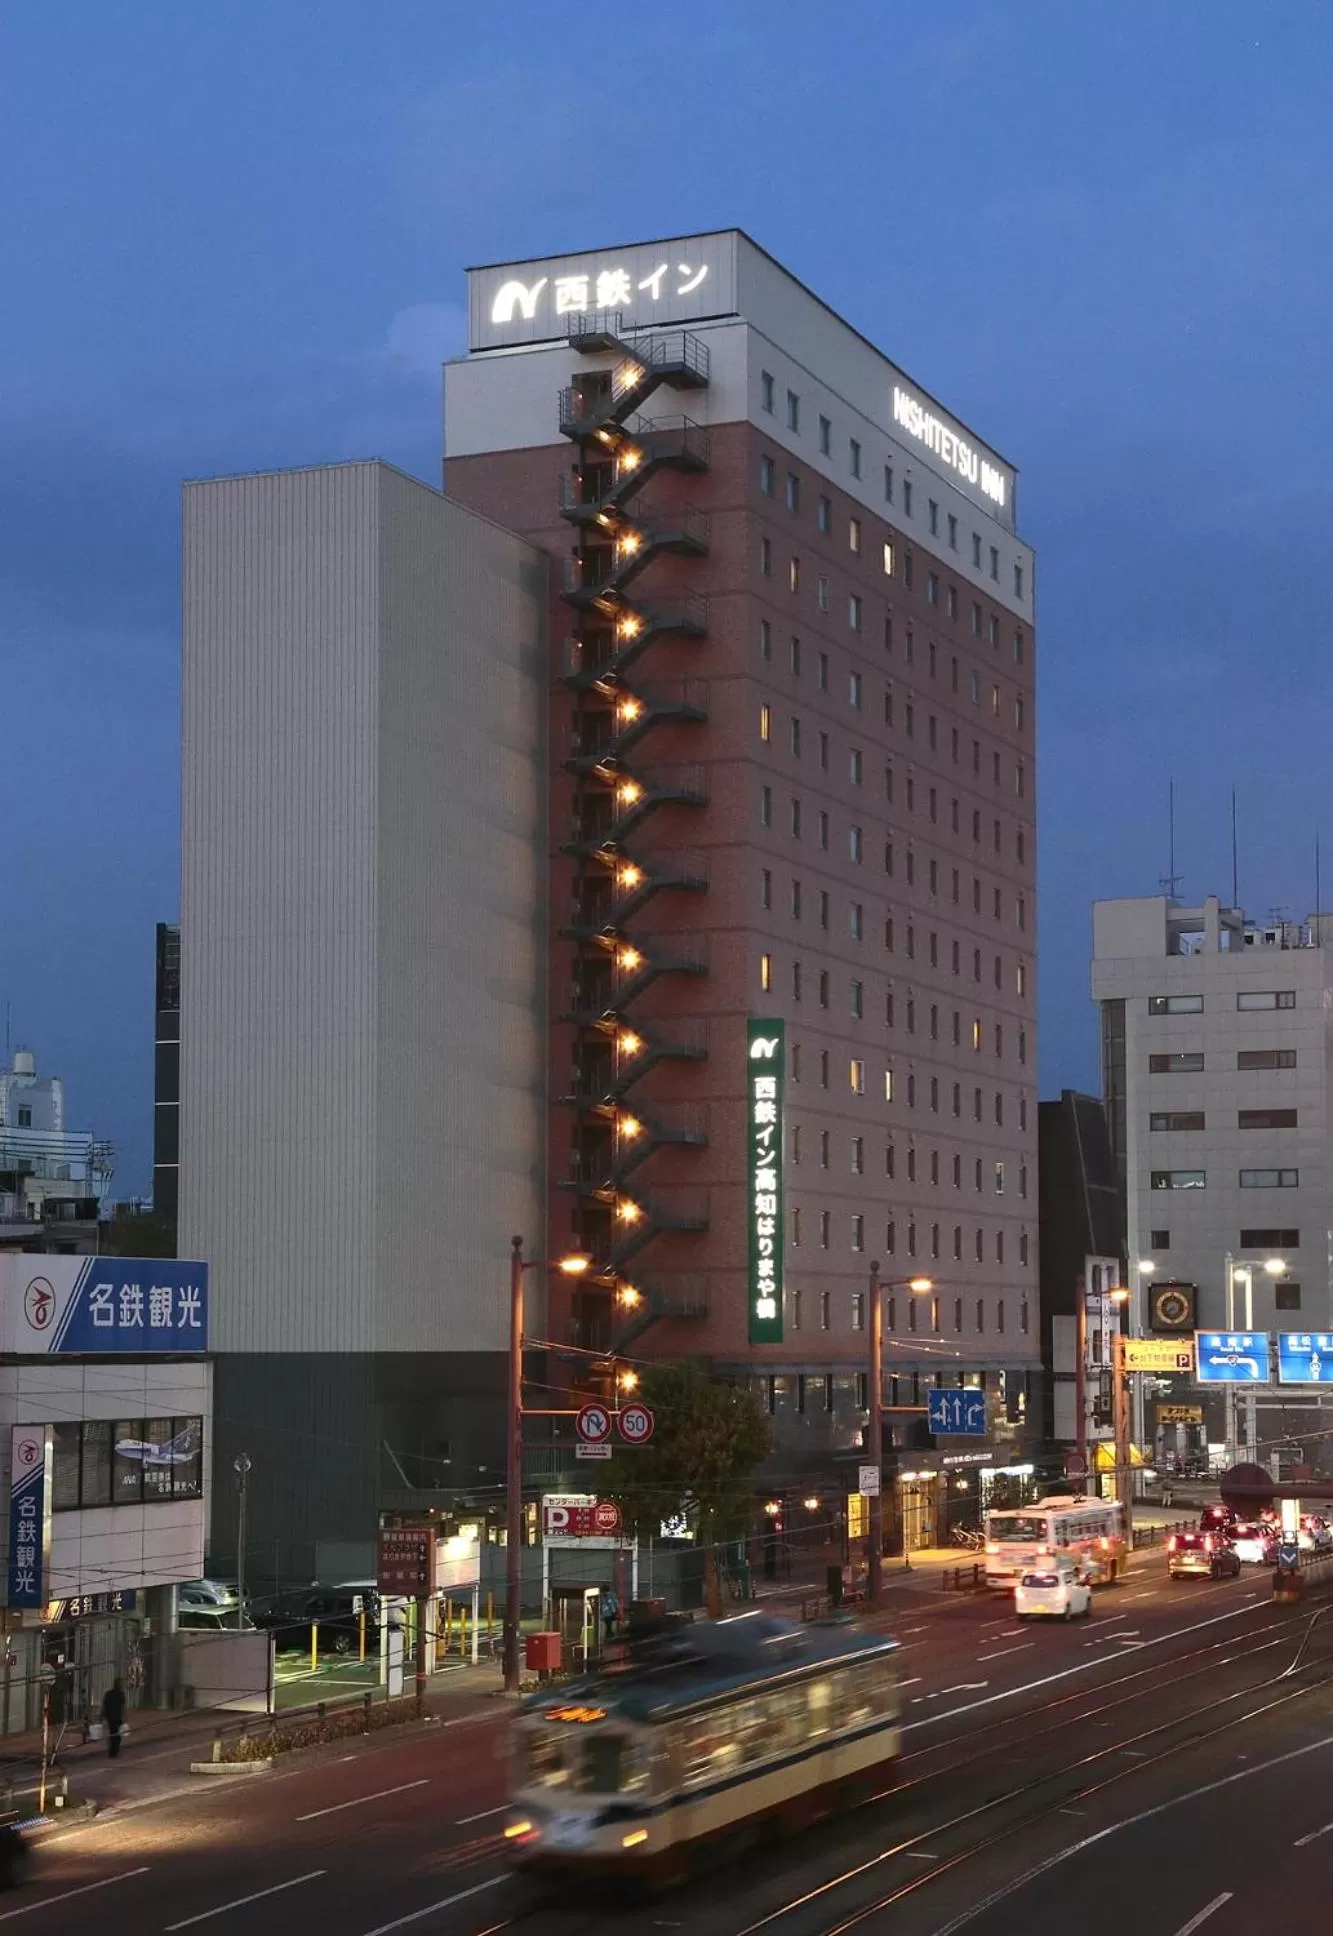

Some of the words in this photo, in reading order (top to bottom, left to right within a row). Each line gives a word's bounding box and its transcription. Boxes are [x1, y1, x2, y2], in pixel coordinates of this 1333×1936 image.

[555, 263, 708, 315] 西鉄イン
[893, 387, 977, 483] NISHITETSU
[981, 460, 1005, 507] INN
[88, 1283, 202, 1329] 名鉄観光
[626, 1414, 645, 1433] 50
[15, 1496, 37, 1594] 名鉄観光
